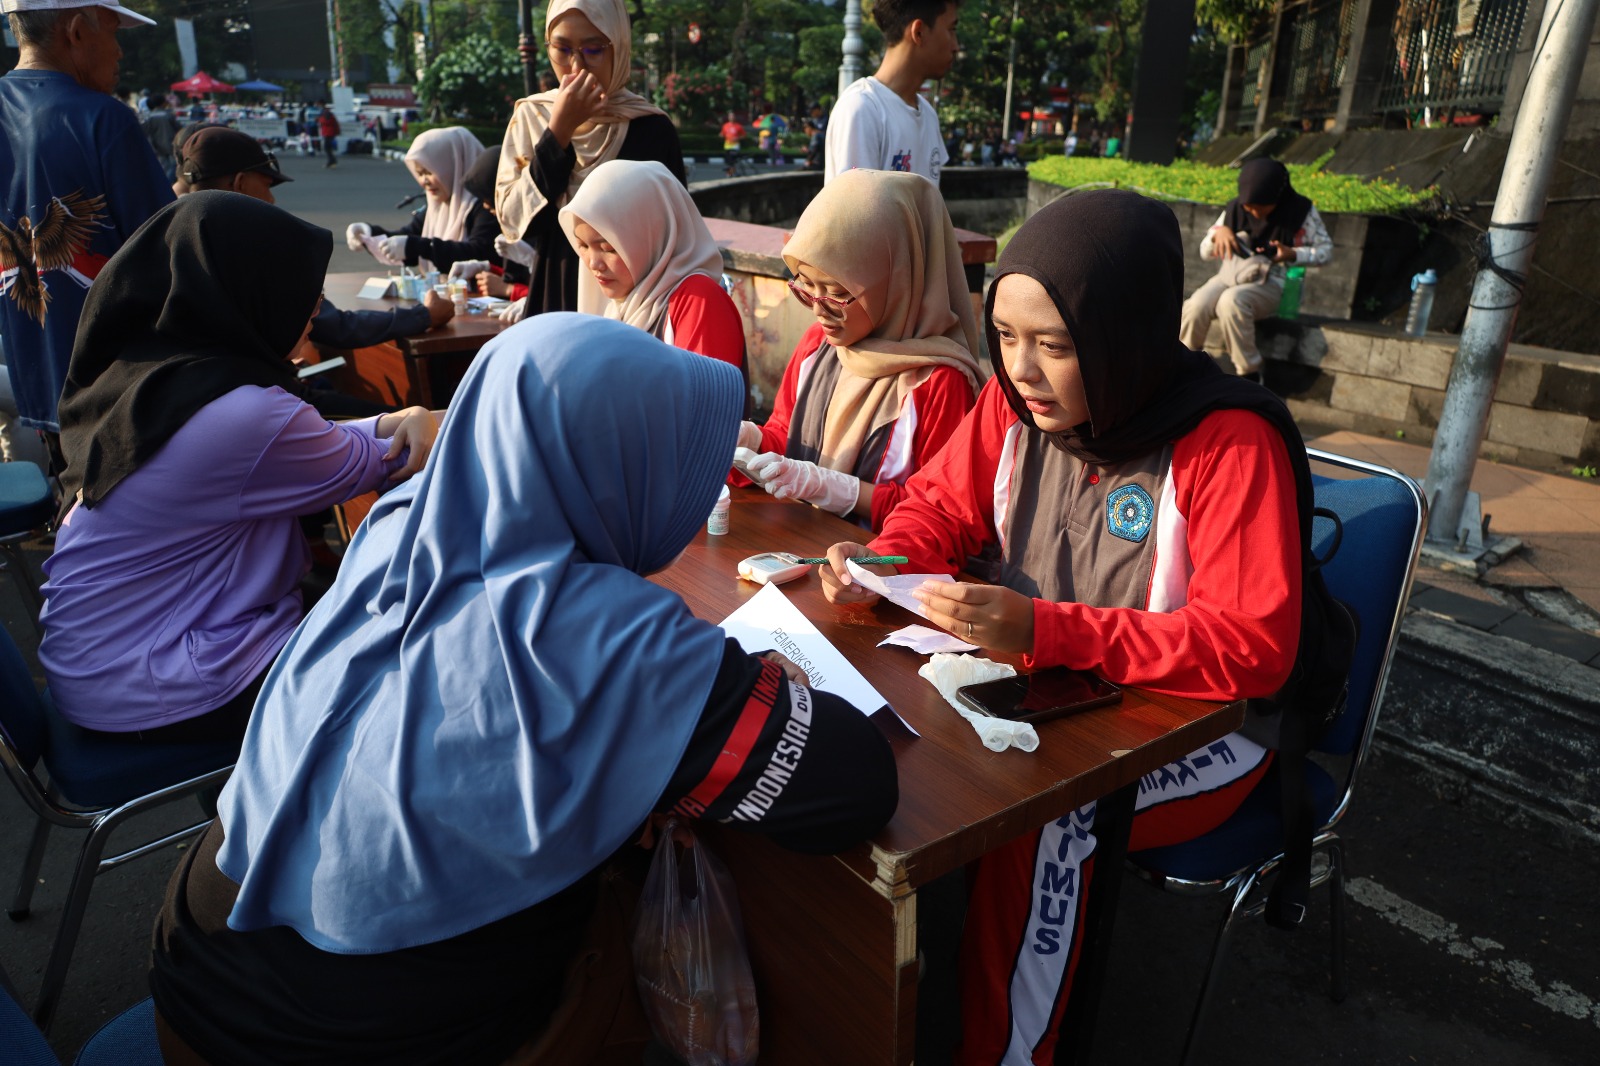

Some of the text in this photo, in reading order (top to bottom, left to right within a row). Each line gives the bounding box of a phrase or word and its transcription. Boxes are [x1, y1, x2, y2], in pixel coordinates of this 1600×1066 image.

[751, 656, 785, 709] INDO
[769, 627, 827, 689] PEMERIKSAAN
[732, 718, 811, 822] INDONESIA
